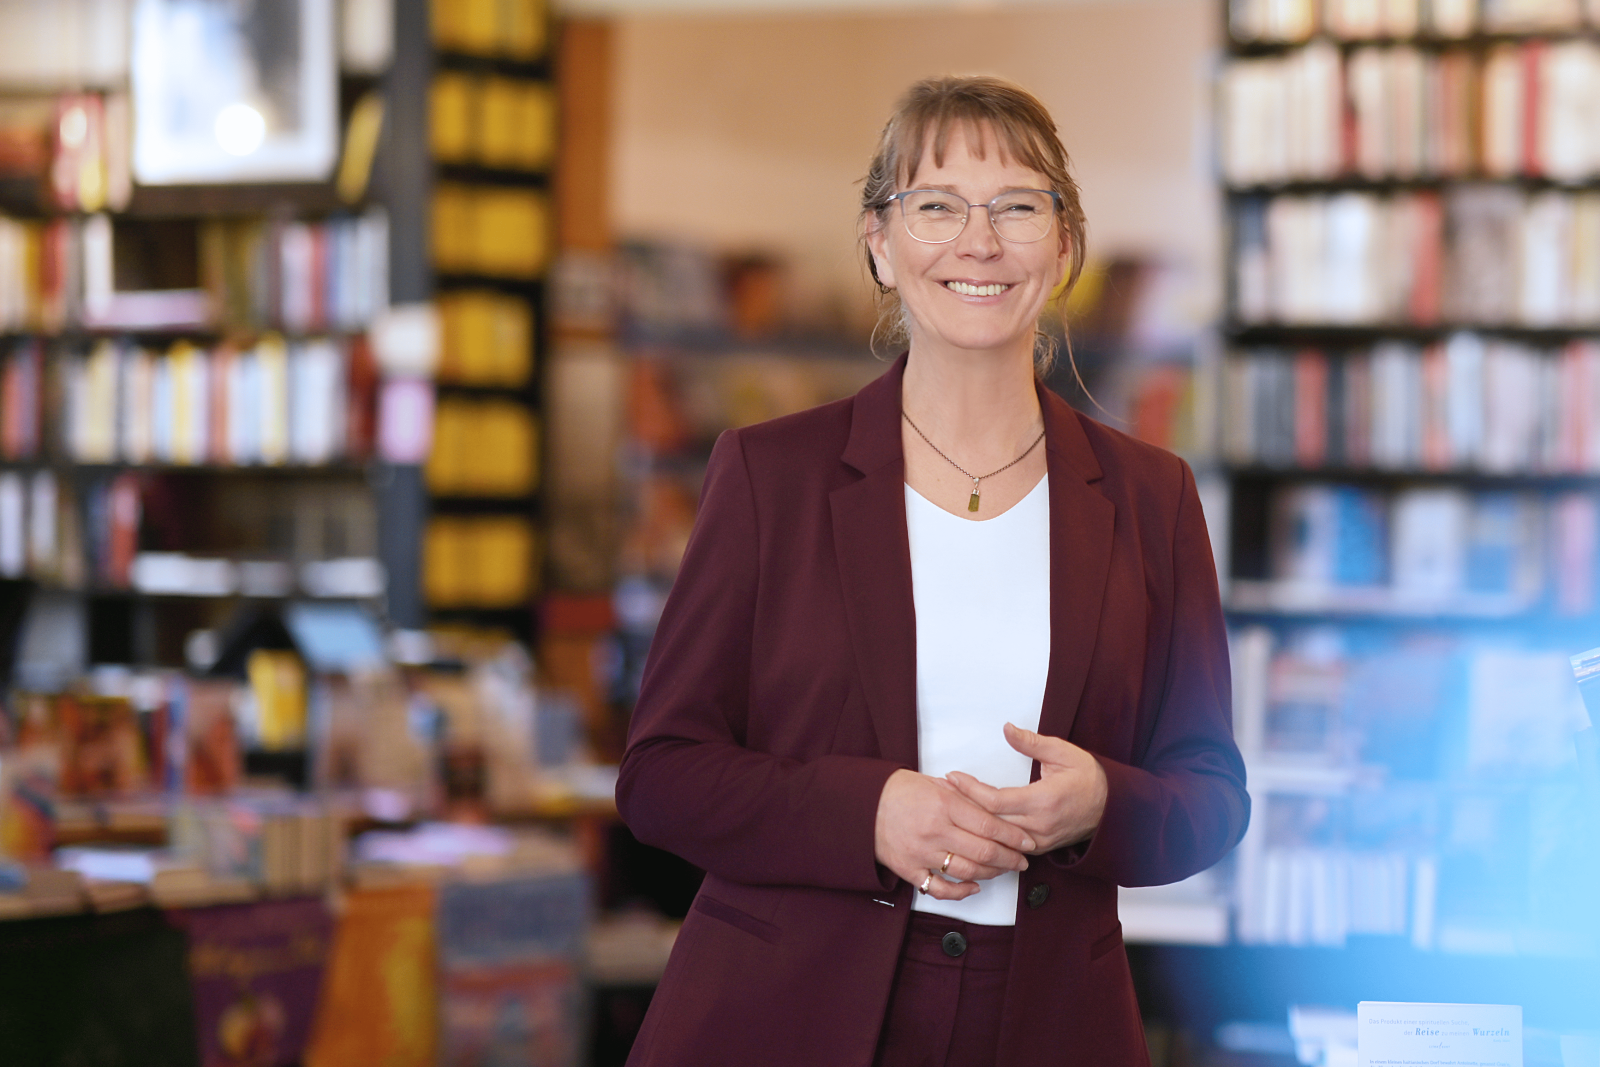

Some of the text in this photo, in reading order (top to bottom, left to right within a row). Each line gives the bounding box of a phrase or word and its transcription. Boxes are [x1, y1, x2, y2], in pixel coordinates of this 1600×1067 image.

[1418, 1018, 1450, 1027] spirituellen
[1415, 1027, 1440, 1036] Reise
[1472, 1027, 1510, 1037] Wurzeln
